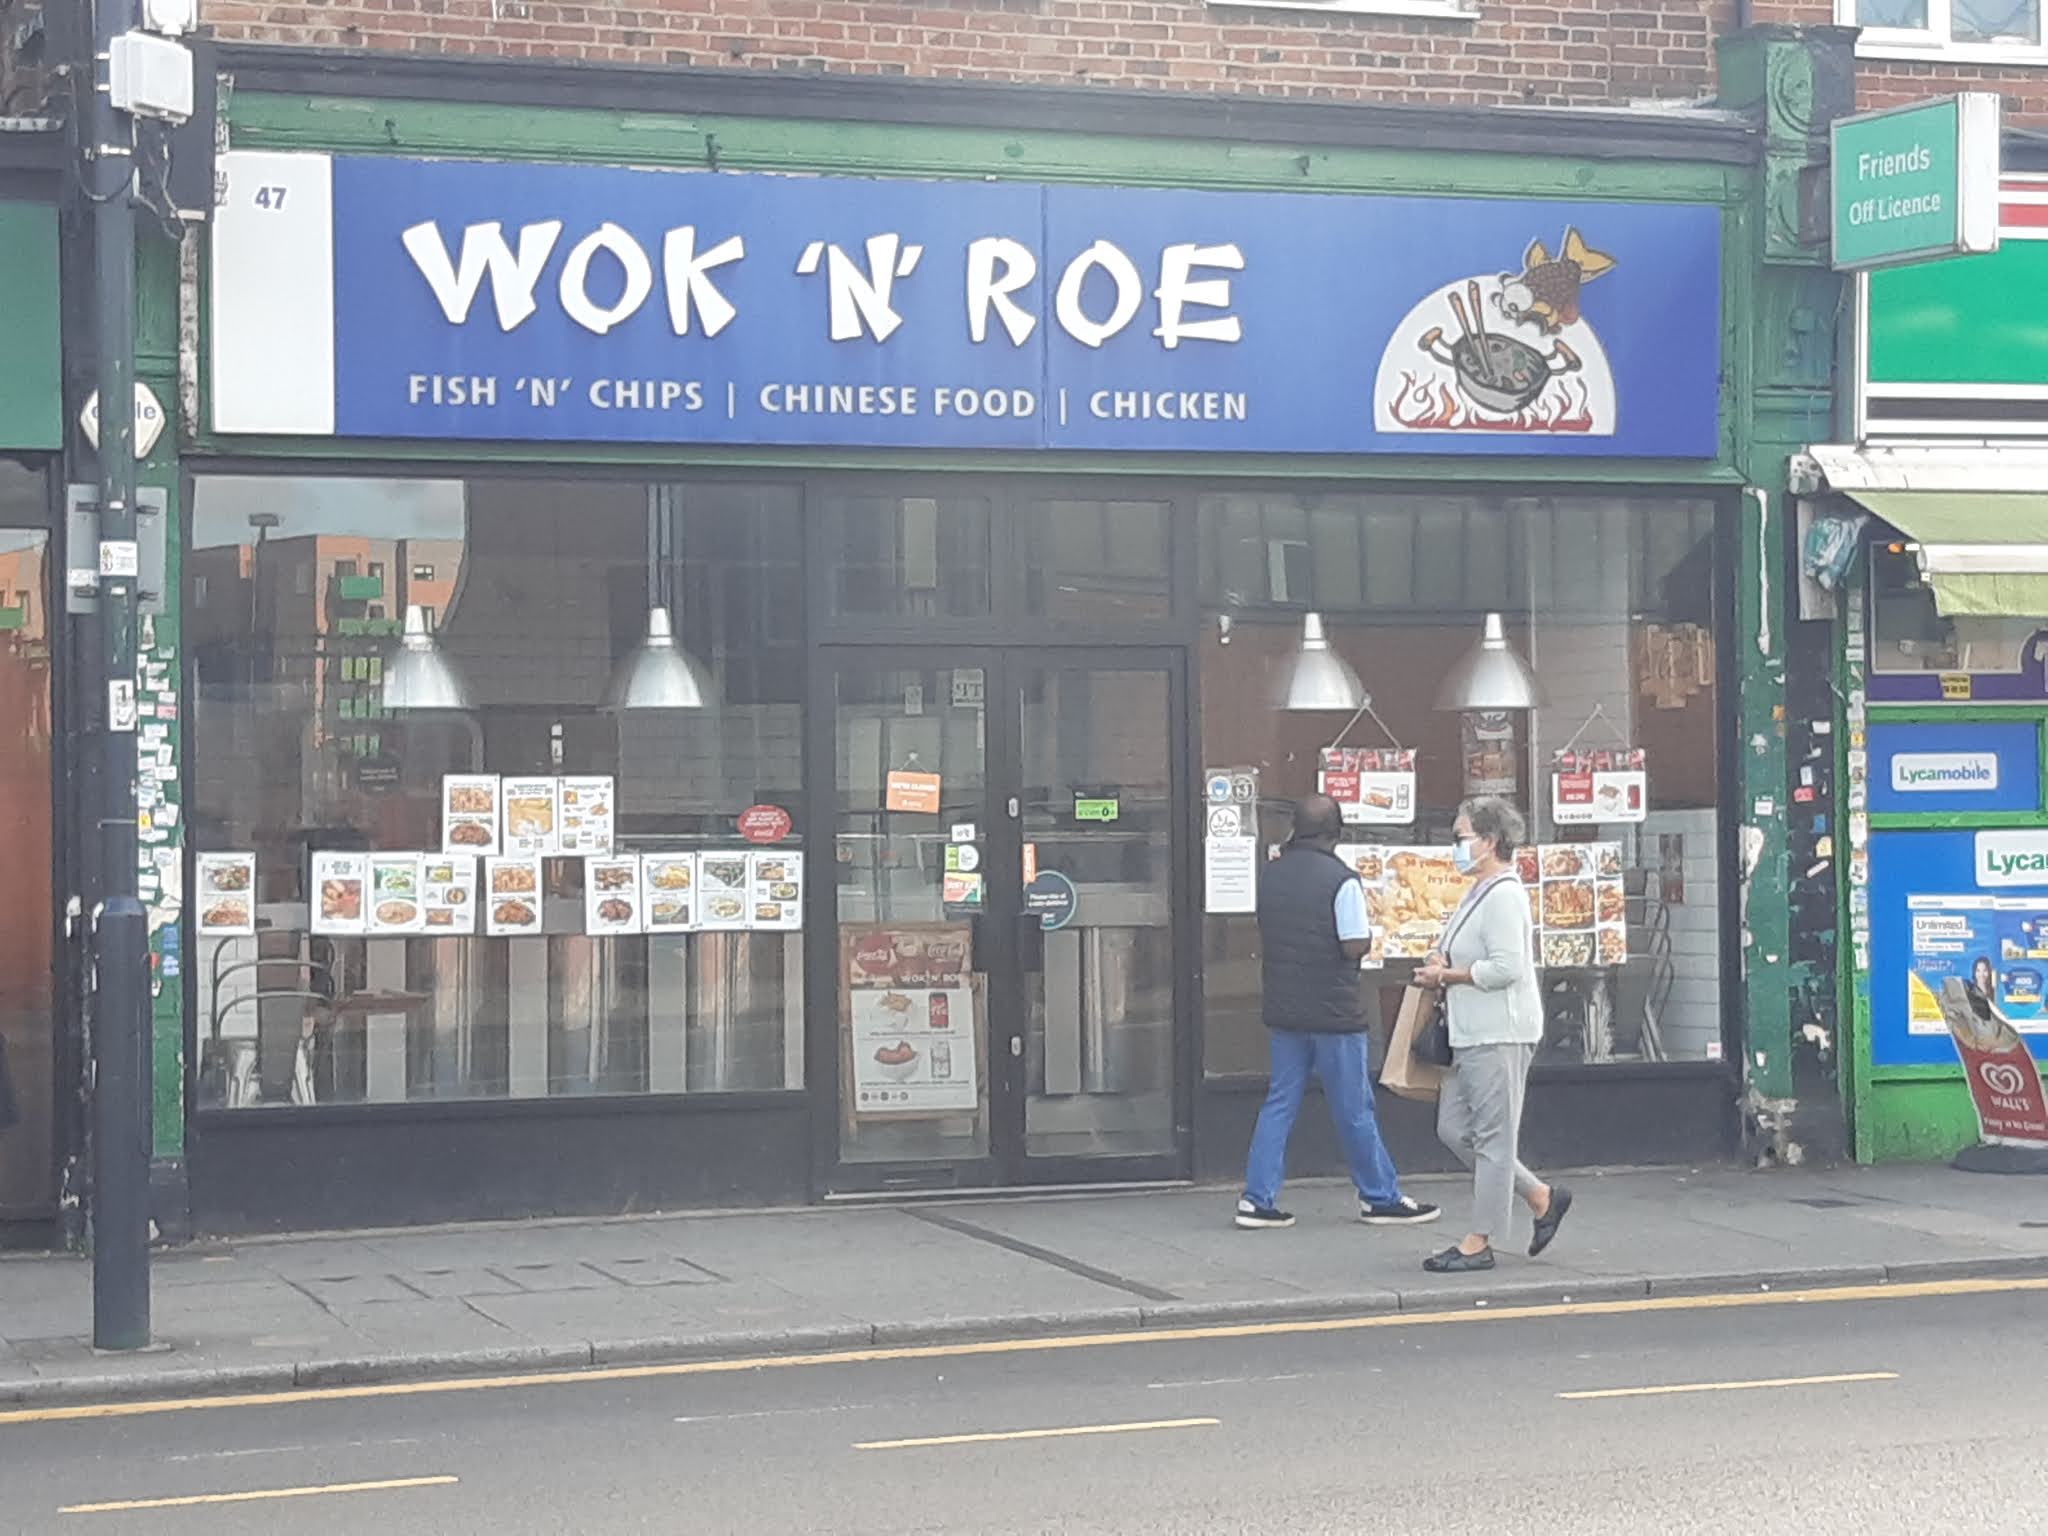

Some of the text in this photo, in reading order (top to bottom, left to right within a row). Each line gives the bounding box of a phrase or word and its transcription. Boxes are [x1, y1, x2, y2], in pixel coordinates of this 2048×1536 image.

[1858, 144, 1931, 181] Friends
[255, 186, 287, 209] 47
[1849, 192, 1942, 225] Off Licence
[402, 219, 745, 337] WOK
[967, 236, 1246, 349] ROE
[410, 375, 496, 405] FISH
[588, 379, 703, 411] CHIPS
[760, 384, 916, 415] CHINESE
[934, 388, 1035, 418] FOOD
[1090, 391, 1246, 421] CHICKEN
[1899, 763, 1990, 783] Lycamobile
[1987, 850, 2048, 875] Lyca
[1916, 920, 1963, 930] Unlimited
[1990, 1095, 2031, 1111] WALL'S
